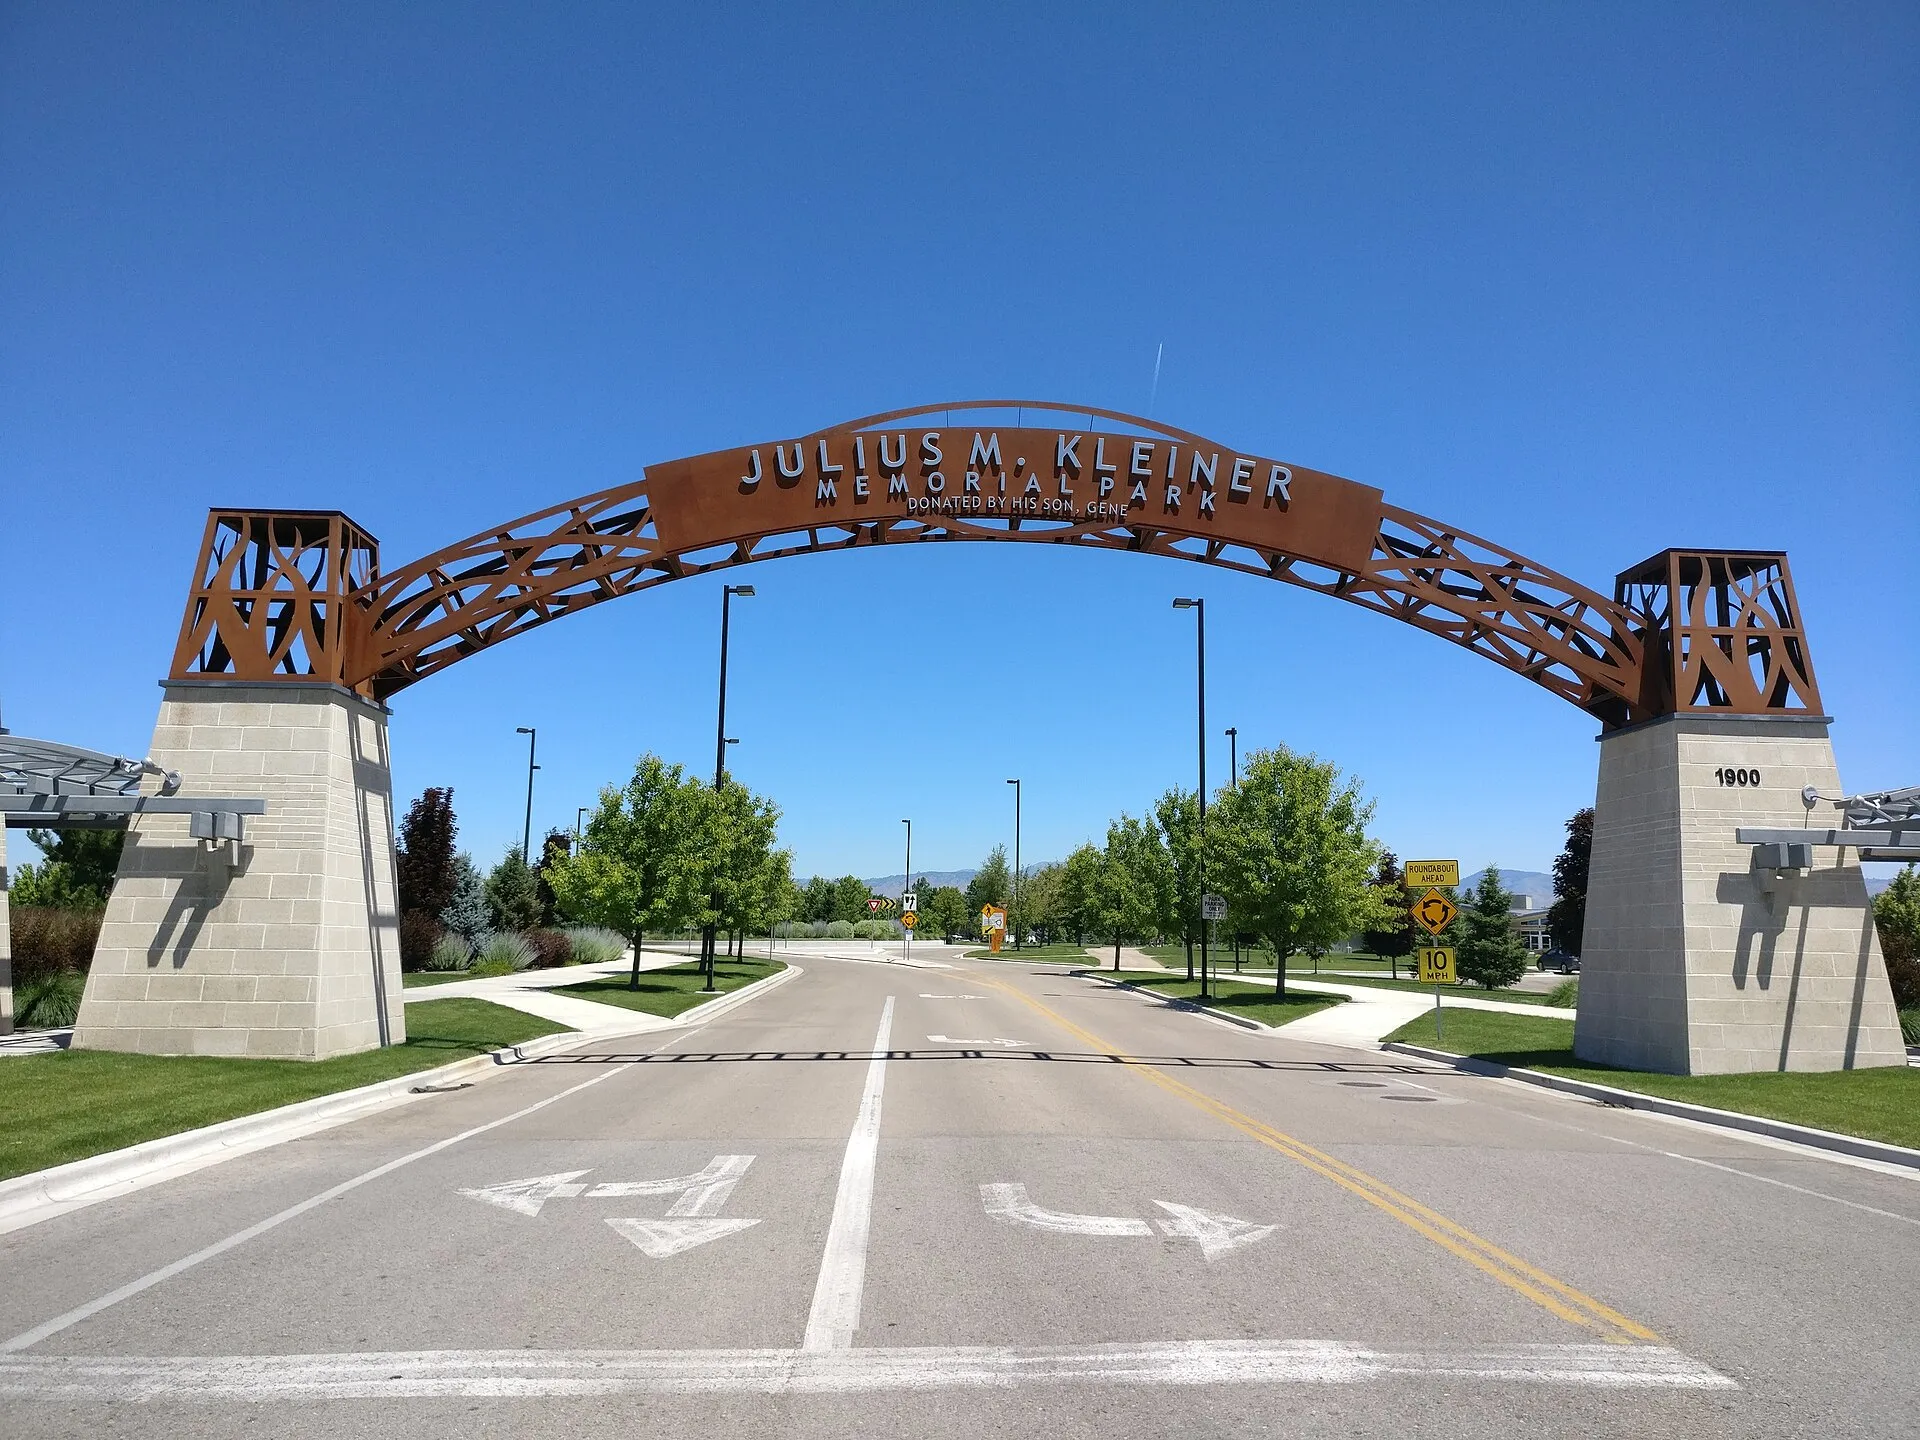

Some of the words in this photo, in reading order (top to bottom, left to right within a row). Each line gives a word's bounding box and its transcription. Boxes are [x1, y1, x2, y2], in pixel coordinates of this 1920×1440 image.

[741, 432, 943, 484] JULIUS
[969, 432, 1026, 466] M.
[1057, 434, 1293, 501] KLEINER
[817, 471, 1074, 499] MEMORIAL
[1100, 476, 1216, 512] PARK
[908, 495, 981, 510] DONATED
[987, 496, 1007, 509] BY
[1012, 496, 1037, 510] HIS
[1043, 498, 1080, 514] SON,
[1087, 501, 1129, 517] GENE
[1714, 767, 1761, 787] 1900
[1409, 864, 1455, 874] ROUNDABOUT
[1421, 874, 1445, 883] AHEAD
[1426, 950, 1447, 970] 10
